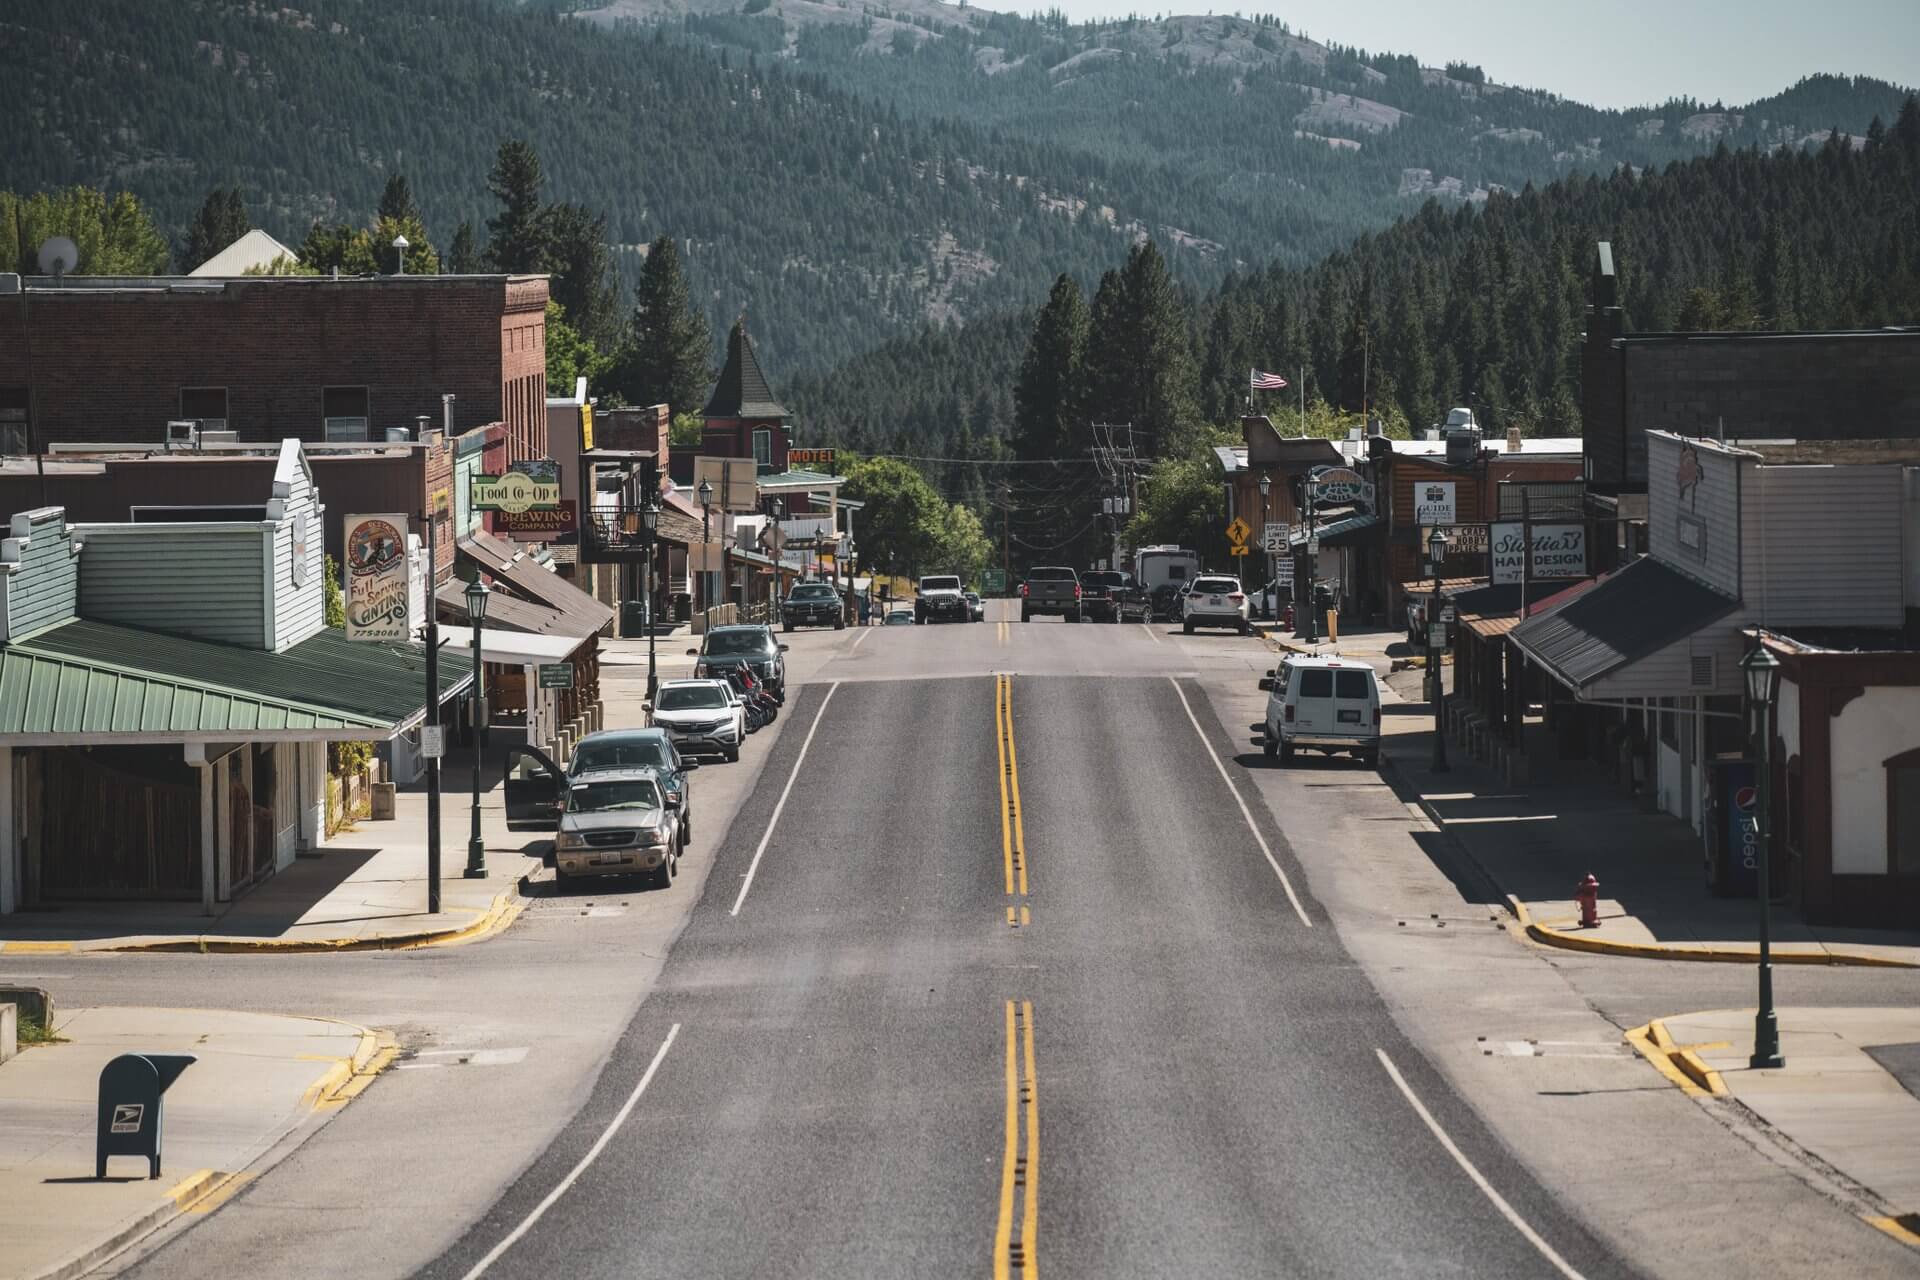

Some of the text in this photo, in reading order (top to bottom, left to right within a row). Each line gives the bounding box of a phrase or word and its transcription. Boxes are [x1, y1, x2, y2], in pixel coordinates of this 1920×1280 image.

[790, 450, 833, 463] MOTEL
[481, 486, 549, 502] Food Co-Op
[500, 511, 571, 522] BREWING
[1267, 539, 1288, 550] 25
[1456, 536, 1486, 545] HOBBY
[1534, 554, 1583, 565] DESIGN
[351, 577, 373, 600] Full
[1739, 818, 1760, 869] pepsi
